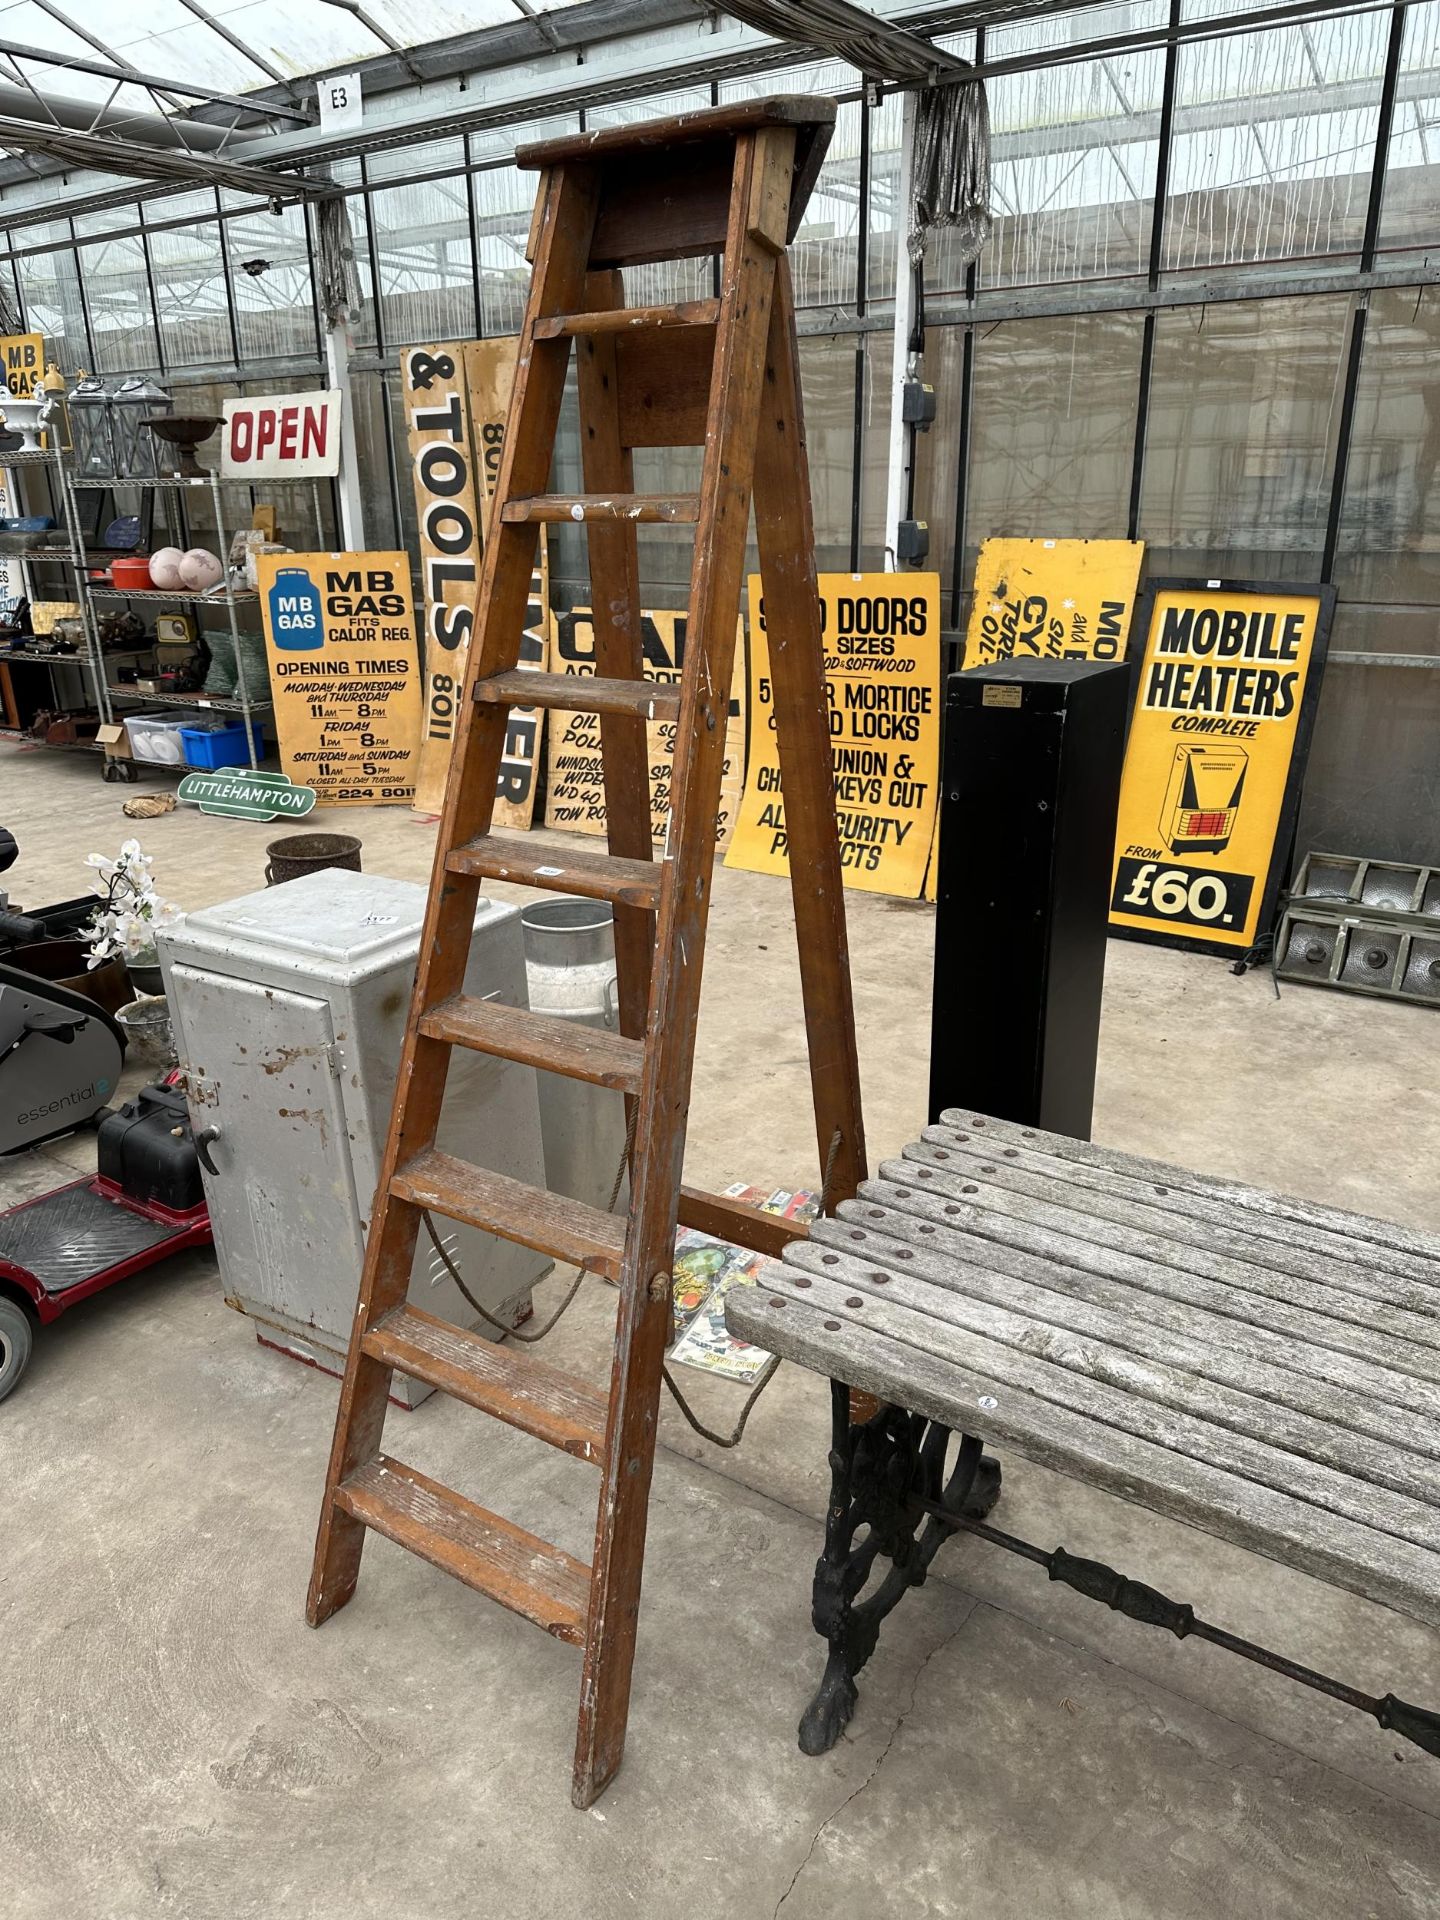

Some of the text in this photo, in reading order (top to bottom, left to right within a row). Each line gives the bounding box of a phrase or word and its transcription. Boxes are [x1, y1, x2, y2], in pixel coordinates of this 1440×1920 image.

[331, 87, 347, 109] E3
[8, 345, 36, 368] MB
[230, 404, 328, 463] OPEN
[407, 347, 476, 652] & TOOLS
[325, 571, 394, 592] MB
[278, 596, 313, 612] MB
[327, 594, 405, 617] GAS
[278, 614, 316, 629] GAS
[349, 617, 380, 627] FITS
[837, 597, 928, 636] DOORS
[328, 627, 412, 642] CALOR REG.
[837, 636, 895, 655] SIZES
[979, 615, 999, 654] OIL
[1157, 607, 1306, 664] MOBILE
[276, 660, 409, 676] OPENING TIMES
[306, 692, 389, 703] and THURSDAY
[844, 683, 932, 714] MORTICE
[1141, 662, 1299, 721] HEATERS
[429, 673, 453, 739] 8011
[323, 721, 370, 732] FRIDAY
[570, 715, 598, 730] OIL
[852, 712, 920, 742] LOCKS
[1170, 715, 1261, 737] COMPLETE
[293, 752, 348, 762] SATURDAY
[366, 750, 411, 760] SUNDAY
[893, 754, 916, 779] &
[306, 777, 337, 785] CLOSED
[564, 771, 604, 786] WIPE
[186, 780, 306, 808] LITTLEHAMPTON
[338, 788, 374, 799] 224
[835, 775, 928, 809] KEYS CUT
[555, 805, 607, 821] TOW RO
[1124, 845, 1163, 860] FROM
[1123, 864, 1233, 924] £60.
[17, 1083, 96, 1125] essential
